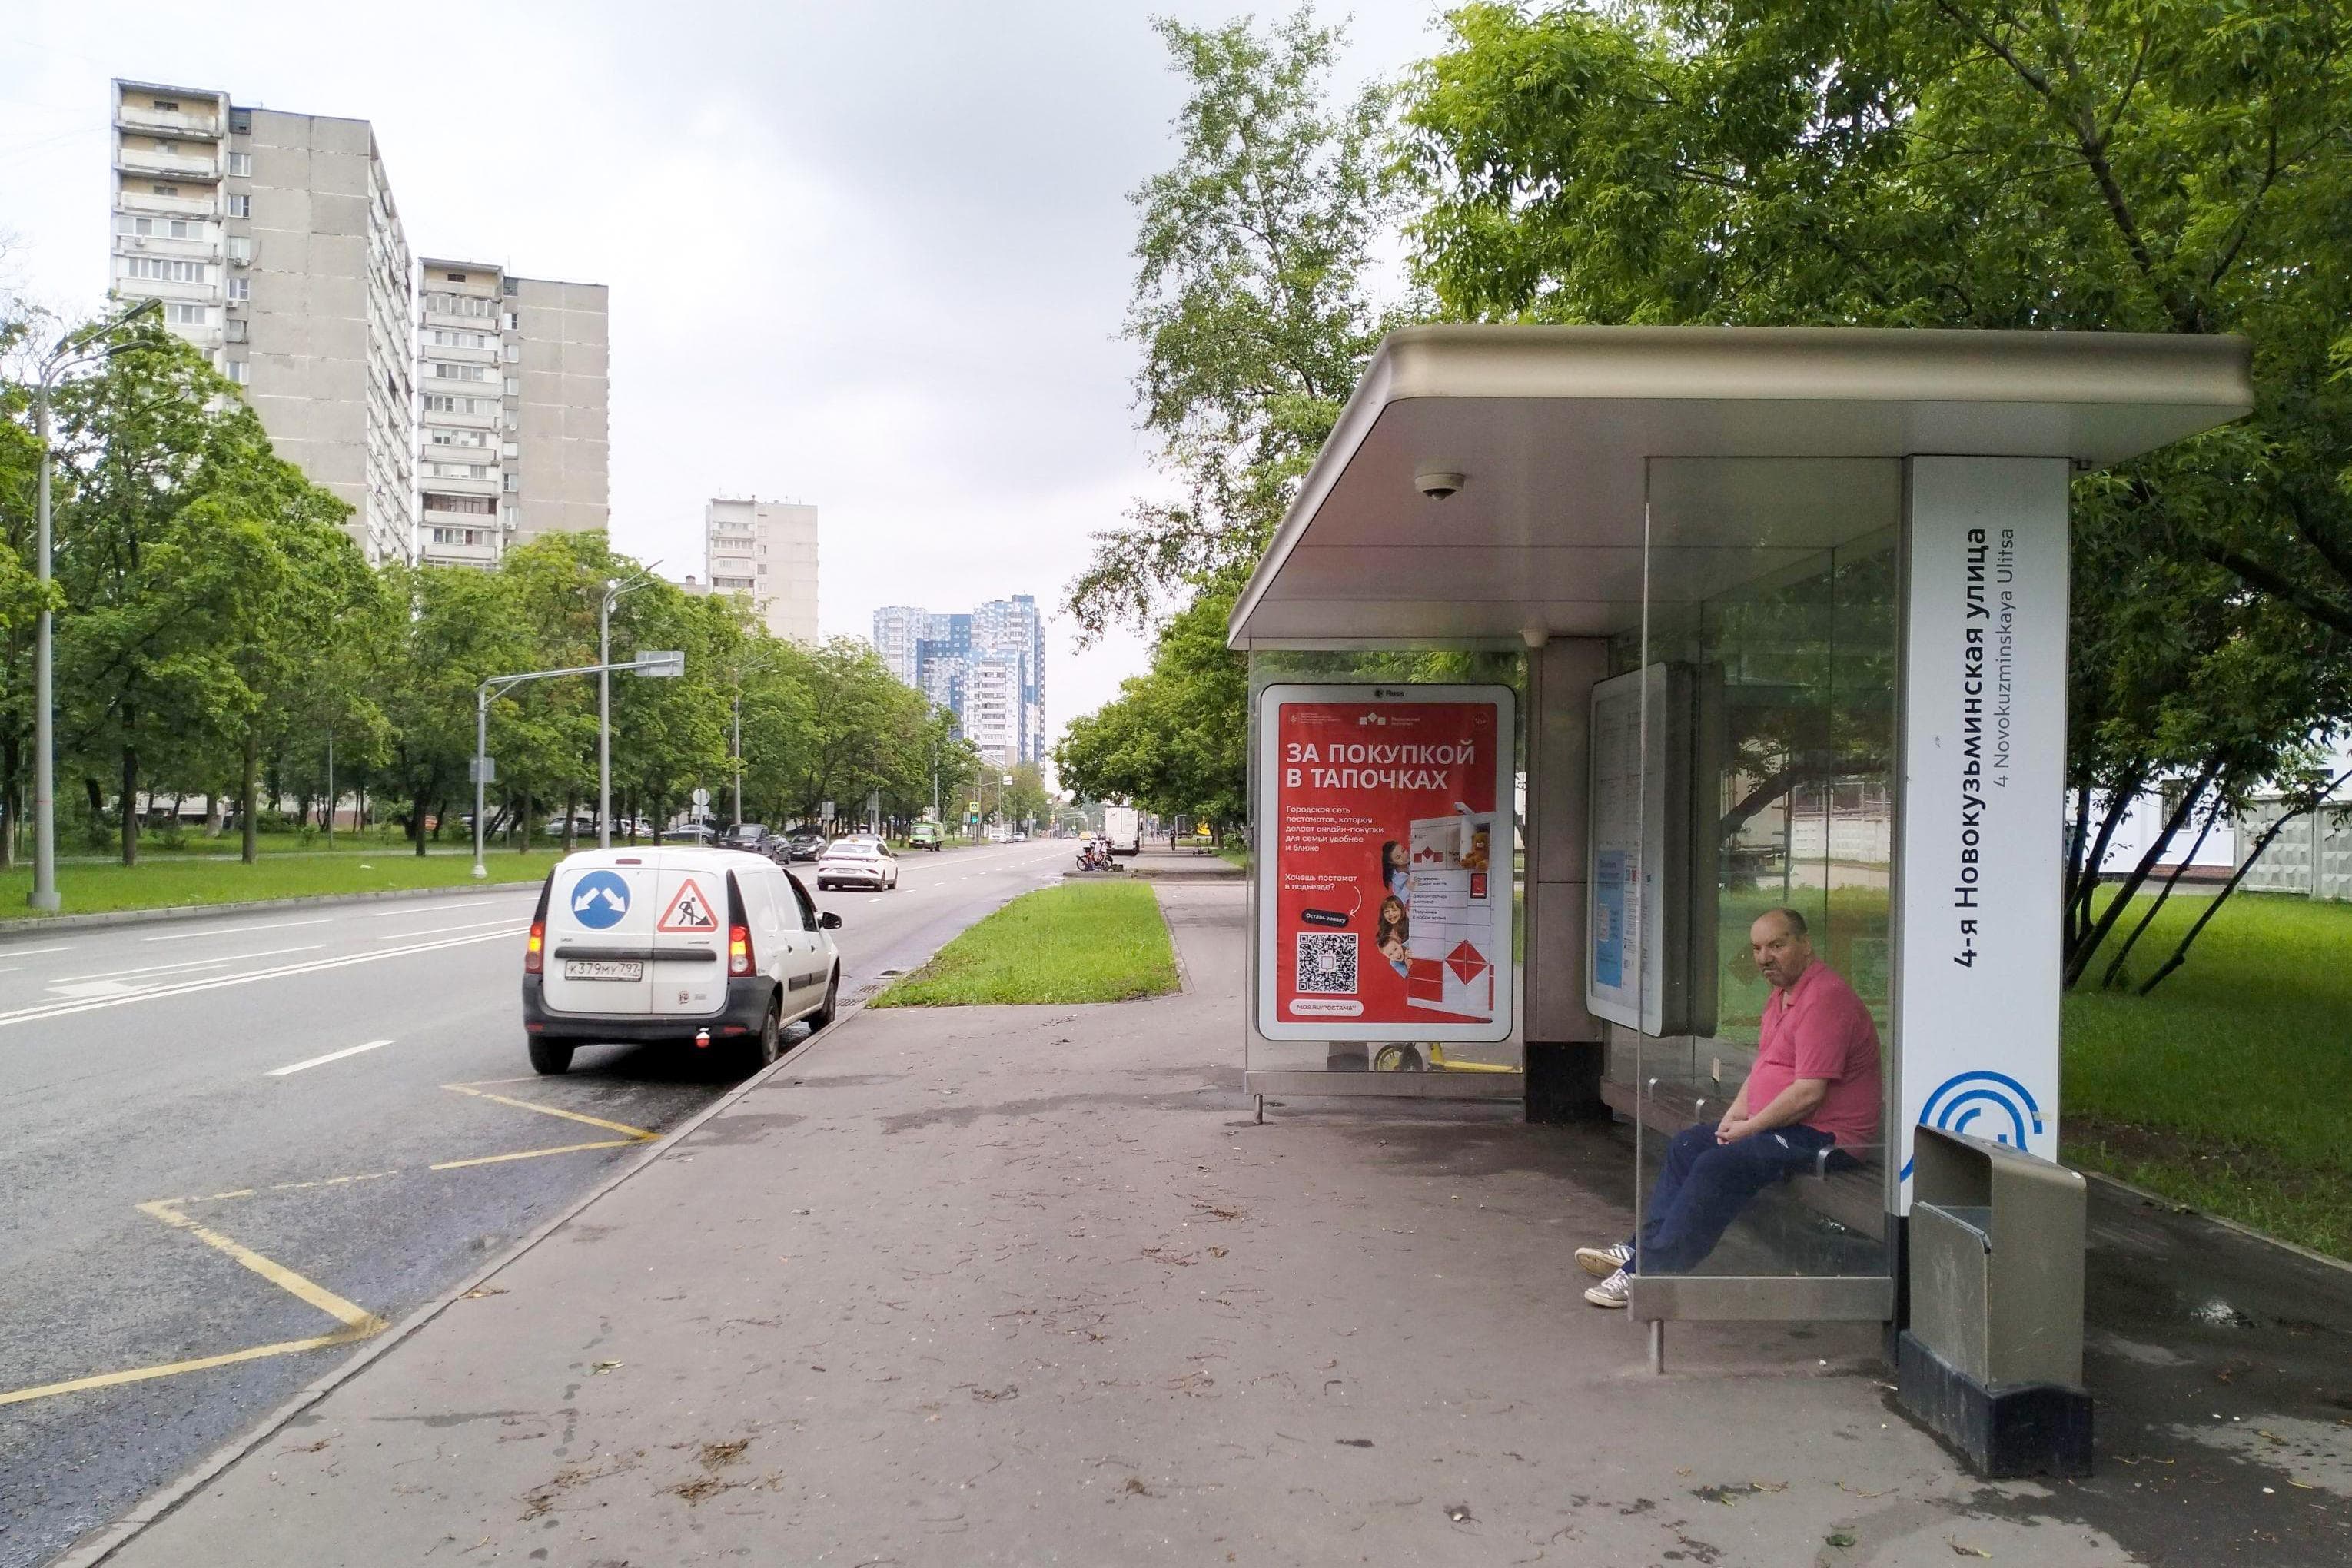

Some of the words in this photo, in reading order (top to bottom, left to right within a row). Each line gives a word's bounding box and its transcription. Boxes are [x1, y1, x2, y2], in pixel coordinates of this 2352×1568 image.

[1966, 528, 1991, 620] улица
[1995, 529, 2014, 583] Ulitsa
[1992, 590, 2017, 769] Novokuzminskaya
[1286, 742, 1320, 763] ЗА
[1329, 739, 1475, 765] ПОКУПКОЙ
[1954, 628, 1987, 908] Новокузьминская
[1286, 768, 1302, 789] В
[1311, 769, 1448, 789] ТАПОЧКАХ
[1992, 775, 2009, 788] 4
[1286, 806, 1330, 814] Городская
[1316, 826, 1384, 834] онлайн-покупки
[1953, 919, 1978, 968] 4-я
